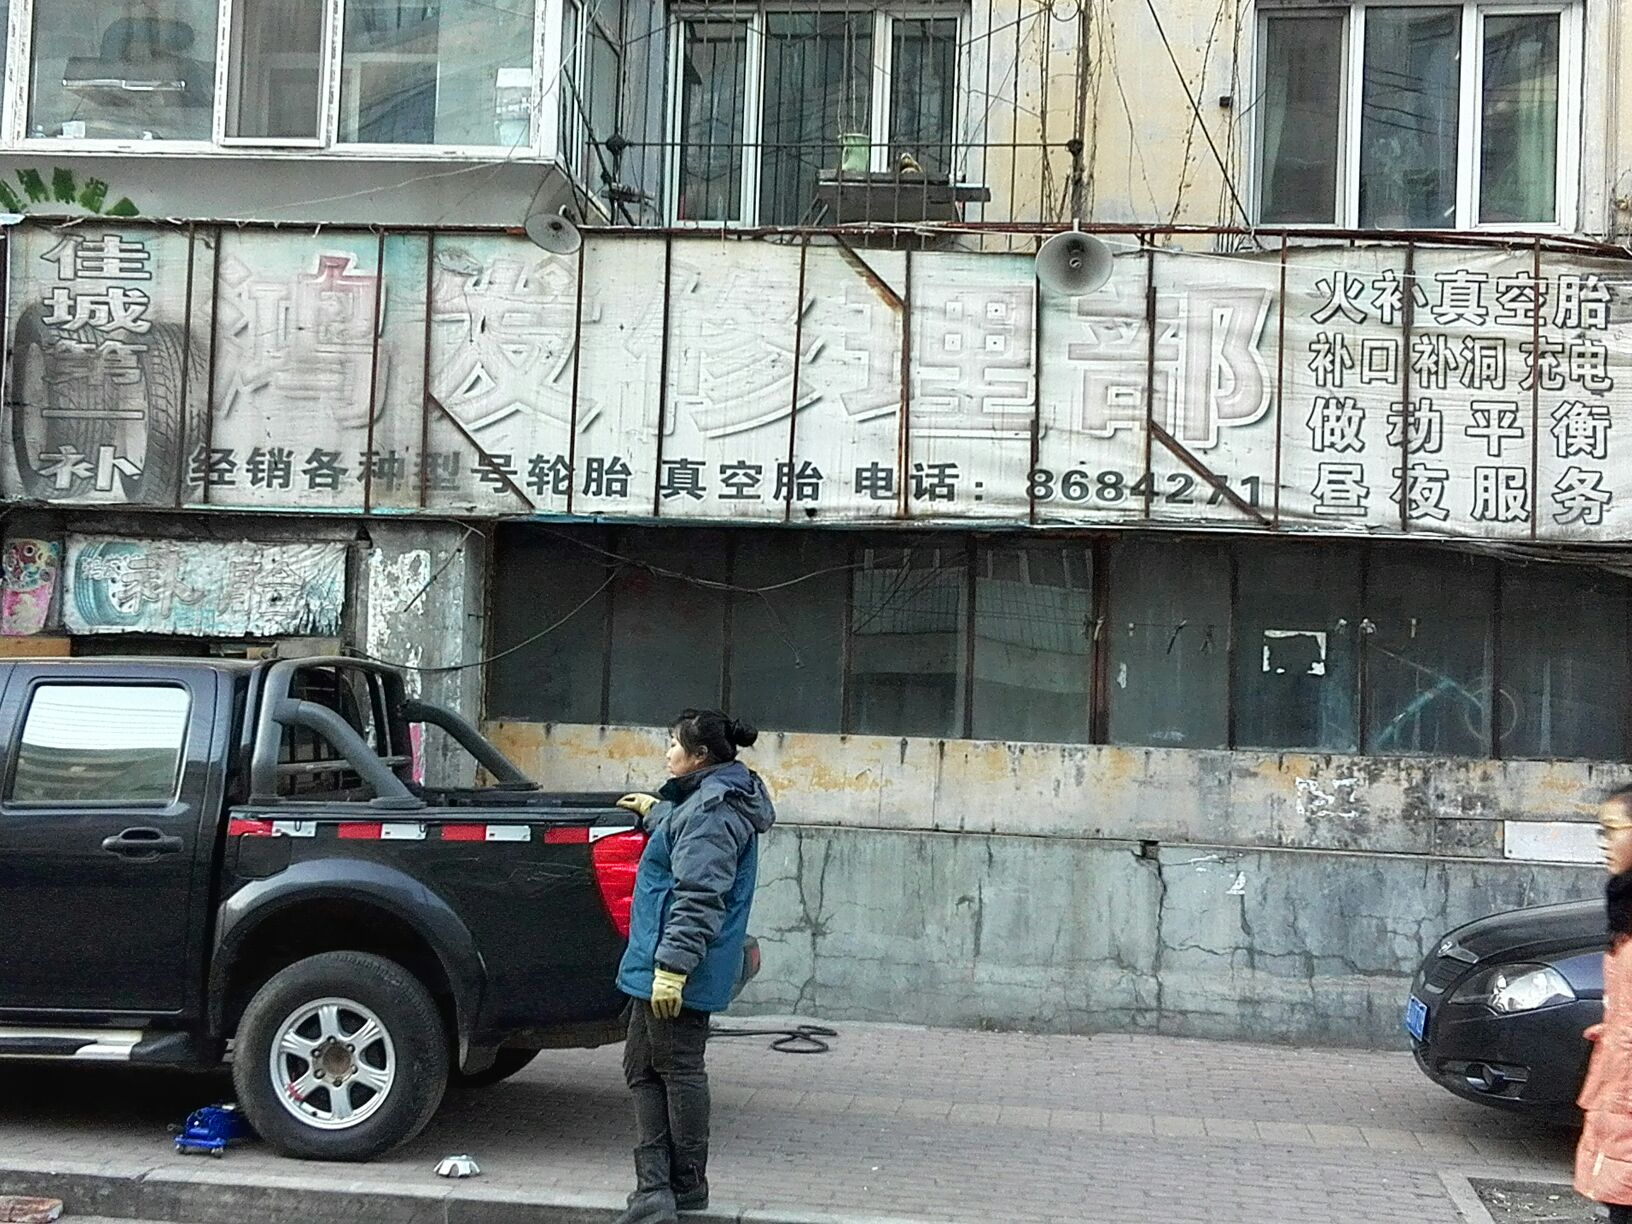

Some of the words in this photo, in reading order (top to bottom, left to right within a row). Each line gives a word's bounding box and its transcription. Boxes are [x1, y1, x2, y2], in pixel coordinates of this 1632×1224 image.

[1310, 269, 1611, 330] 火补真空胎
[1306, 396, 1611, 459] 做动平衡
[188, 446, 632, 497] 经销各种型号轮胎
[660, 456, 824, 501] 真空胎
[1026, 468, 1262, 508] 8684271
[1310, 462, 1613, 525] 昼夜服务
